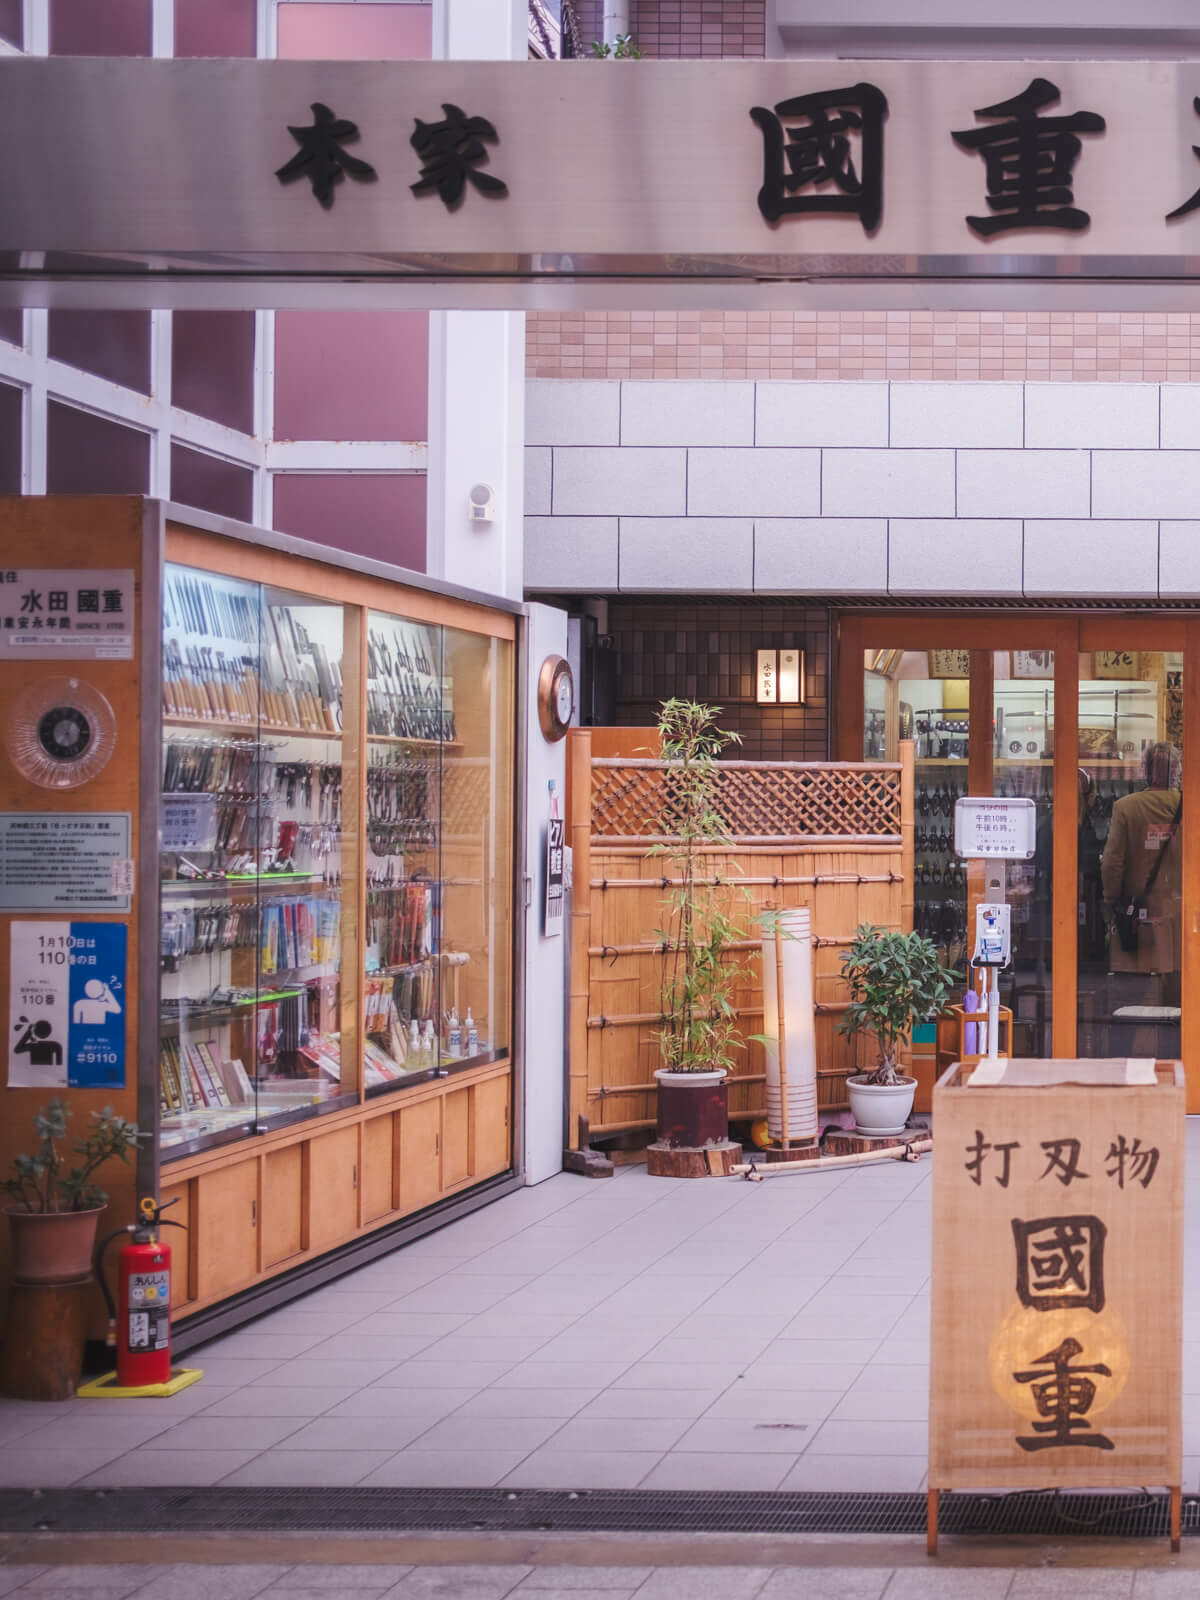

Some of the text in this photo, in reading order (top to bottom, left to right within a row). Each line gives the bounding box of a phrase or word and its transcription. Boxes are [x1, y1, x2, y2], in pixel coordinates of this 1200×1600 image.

[276, 102, 507, 211] 本家
[38, 936, 97, 949] 1月10日は
[22, 995, 55, 1005] 110番
[76, 1053, 118, 1064] #9110
[964, 1130, 1160, 1190] 打刃物
[1011, 1214, 1115, 1452] 國重
